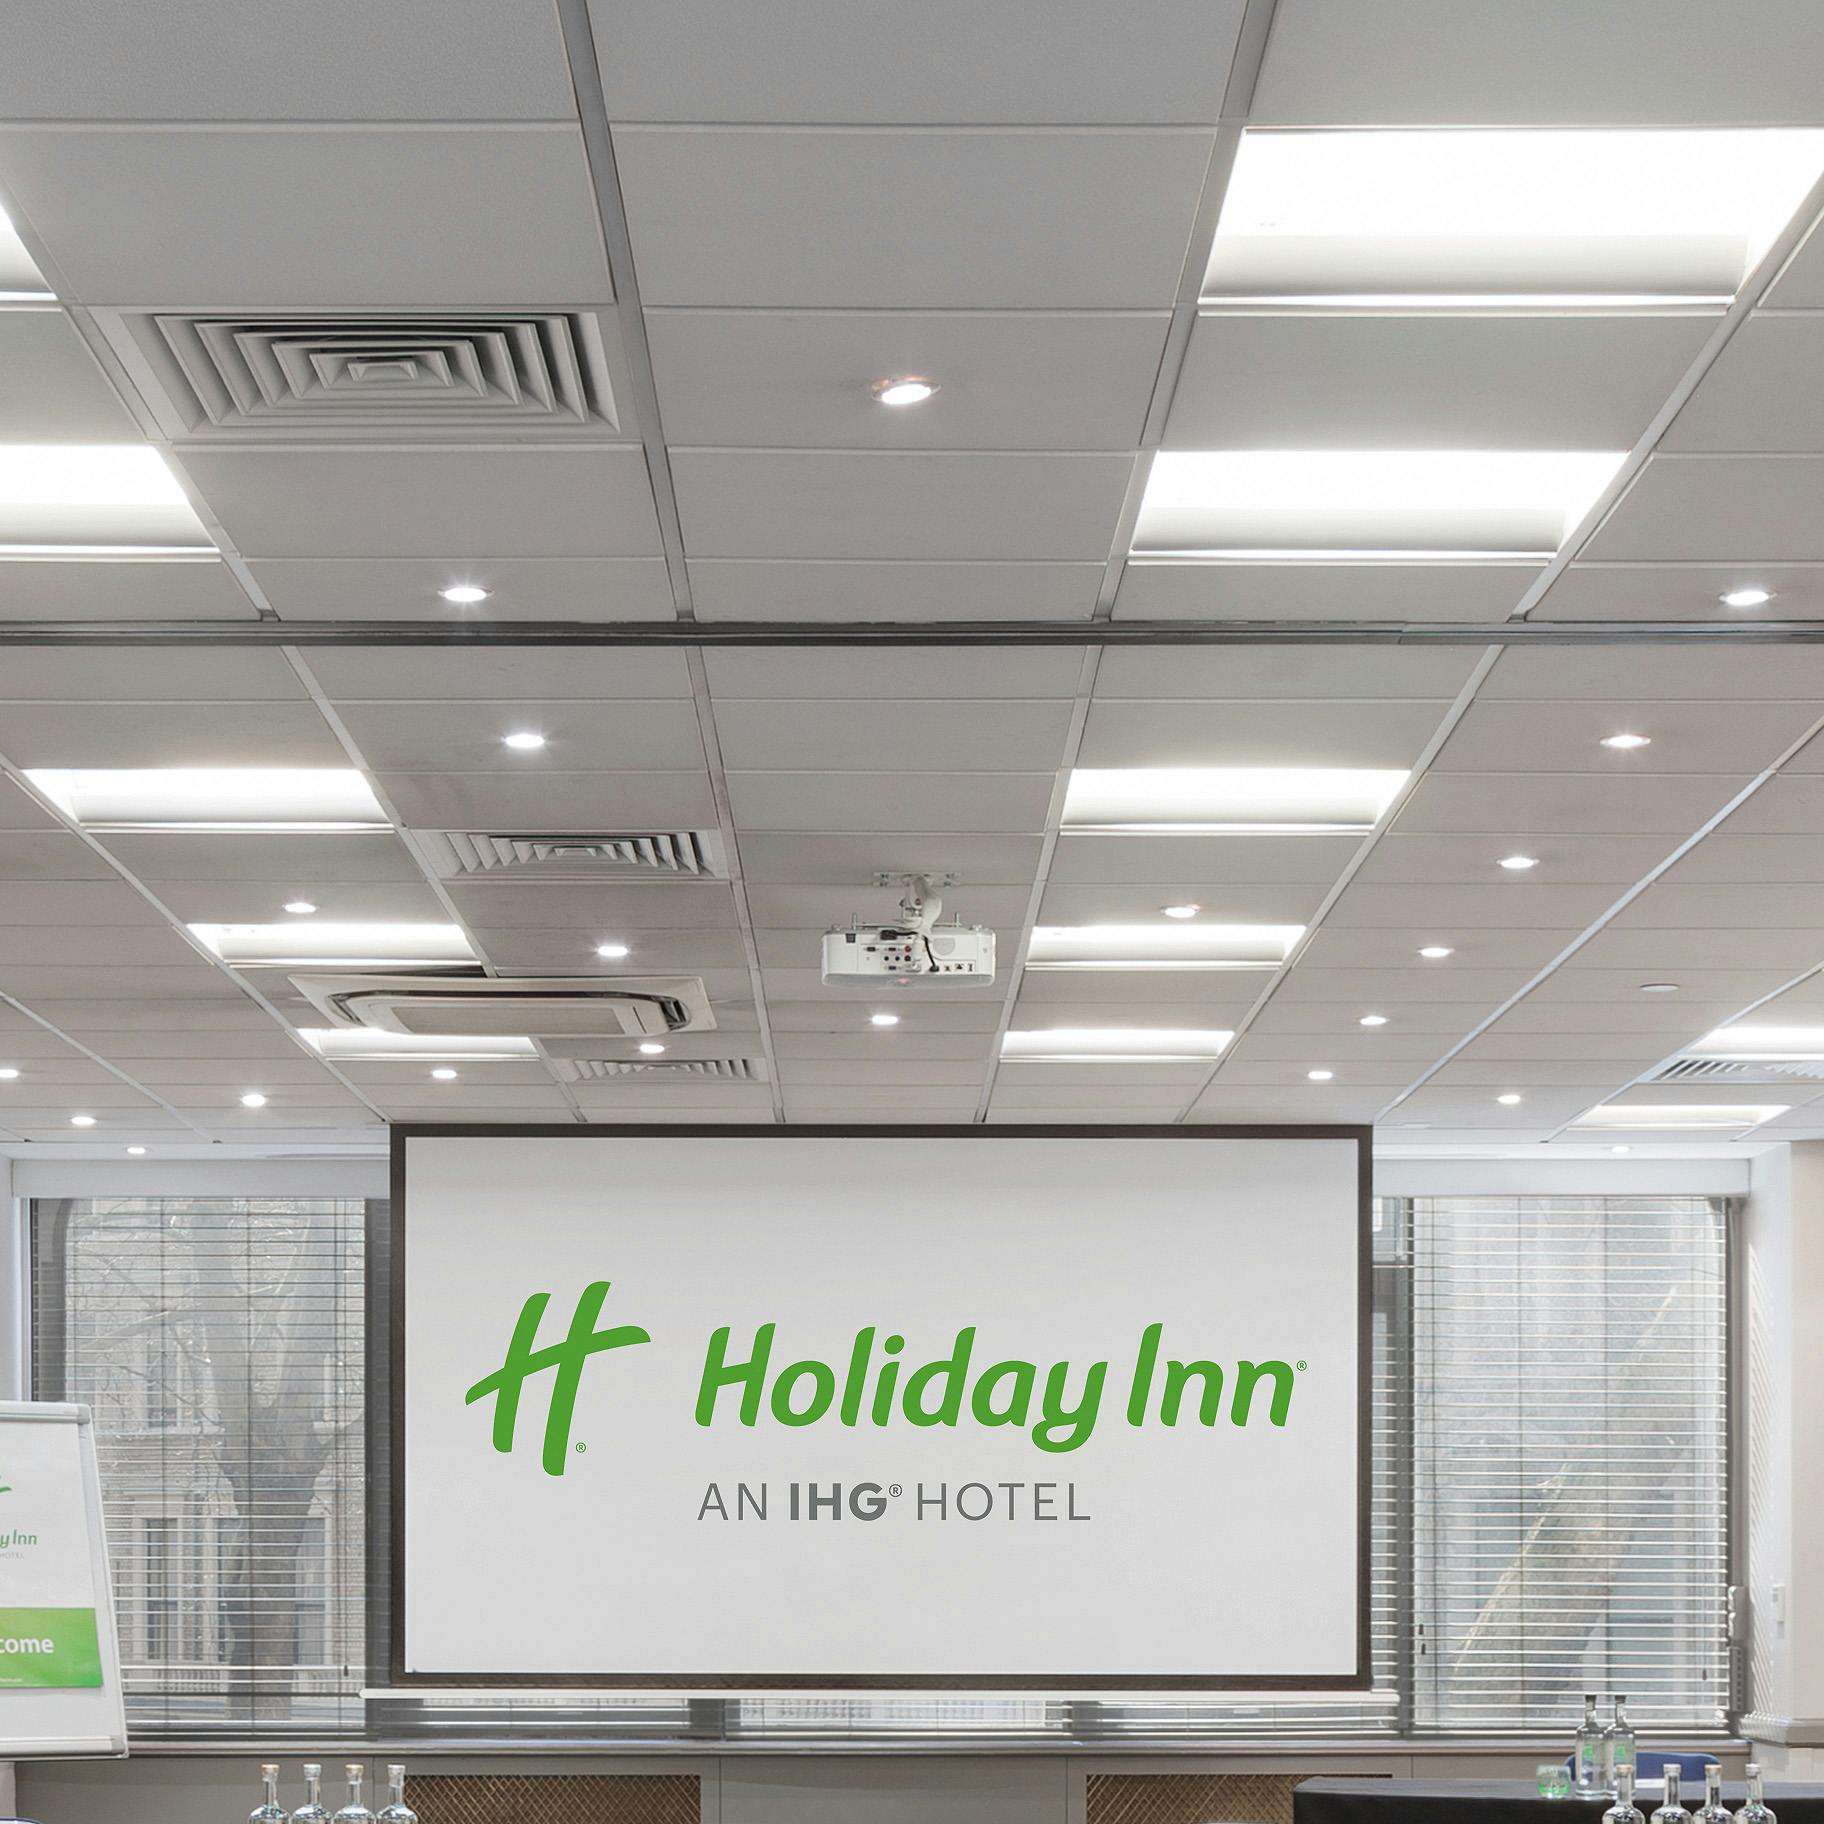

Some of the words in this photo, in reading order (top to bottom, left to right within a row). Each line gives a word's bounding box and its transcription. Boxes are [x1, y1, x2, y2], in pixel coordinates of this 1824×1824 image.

[694, 1322, 1109, 1454] Holiday
[697, 1482, 767, 1521] AN
[917, 1482, 1091, 1522] HOTEL
[12, 1528, 38, 1546] Inn
